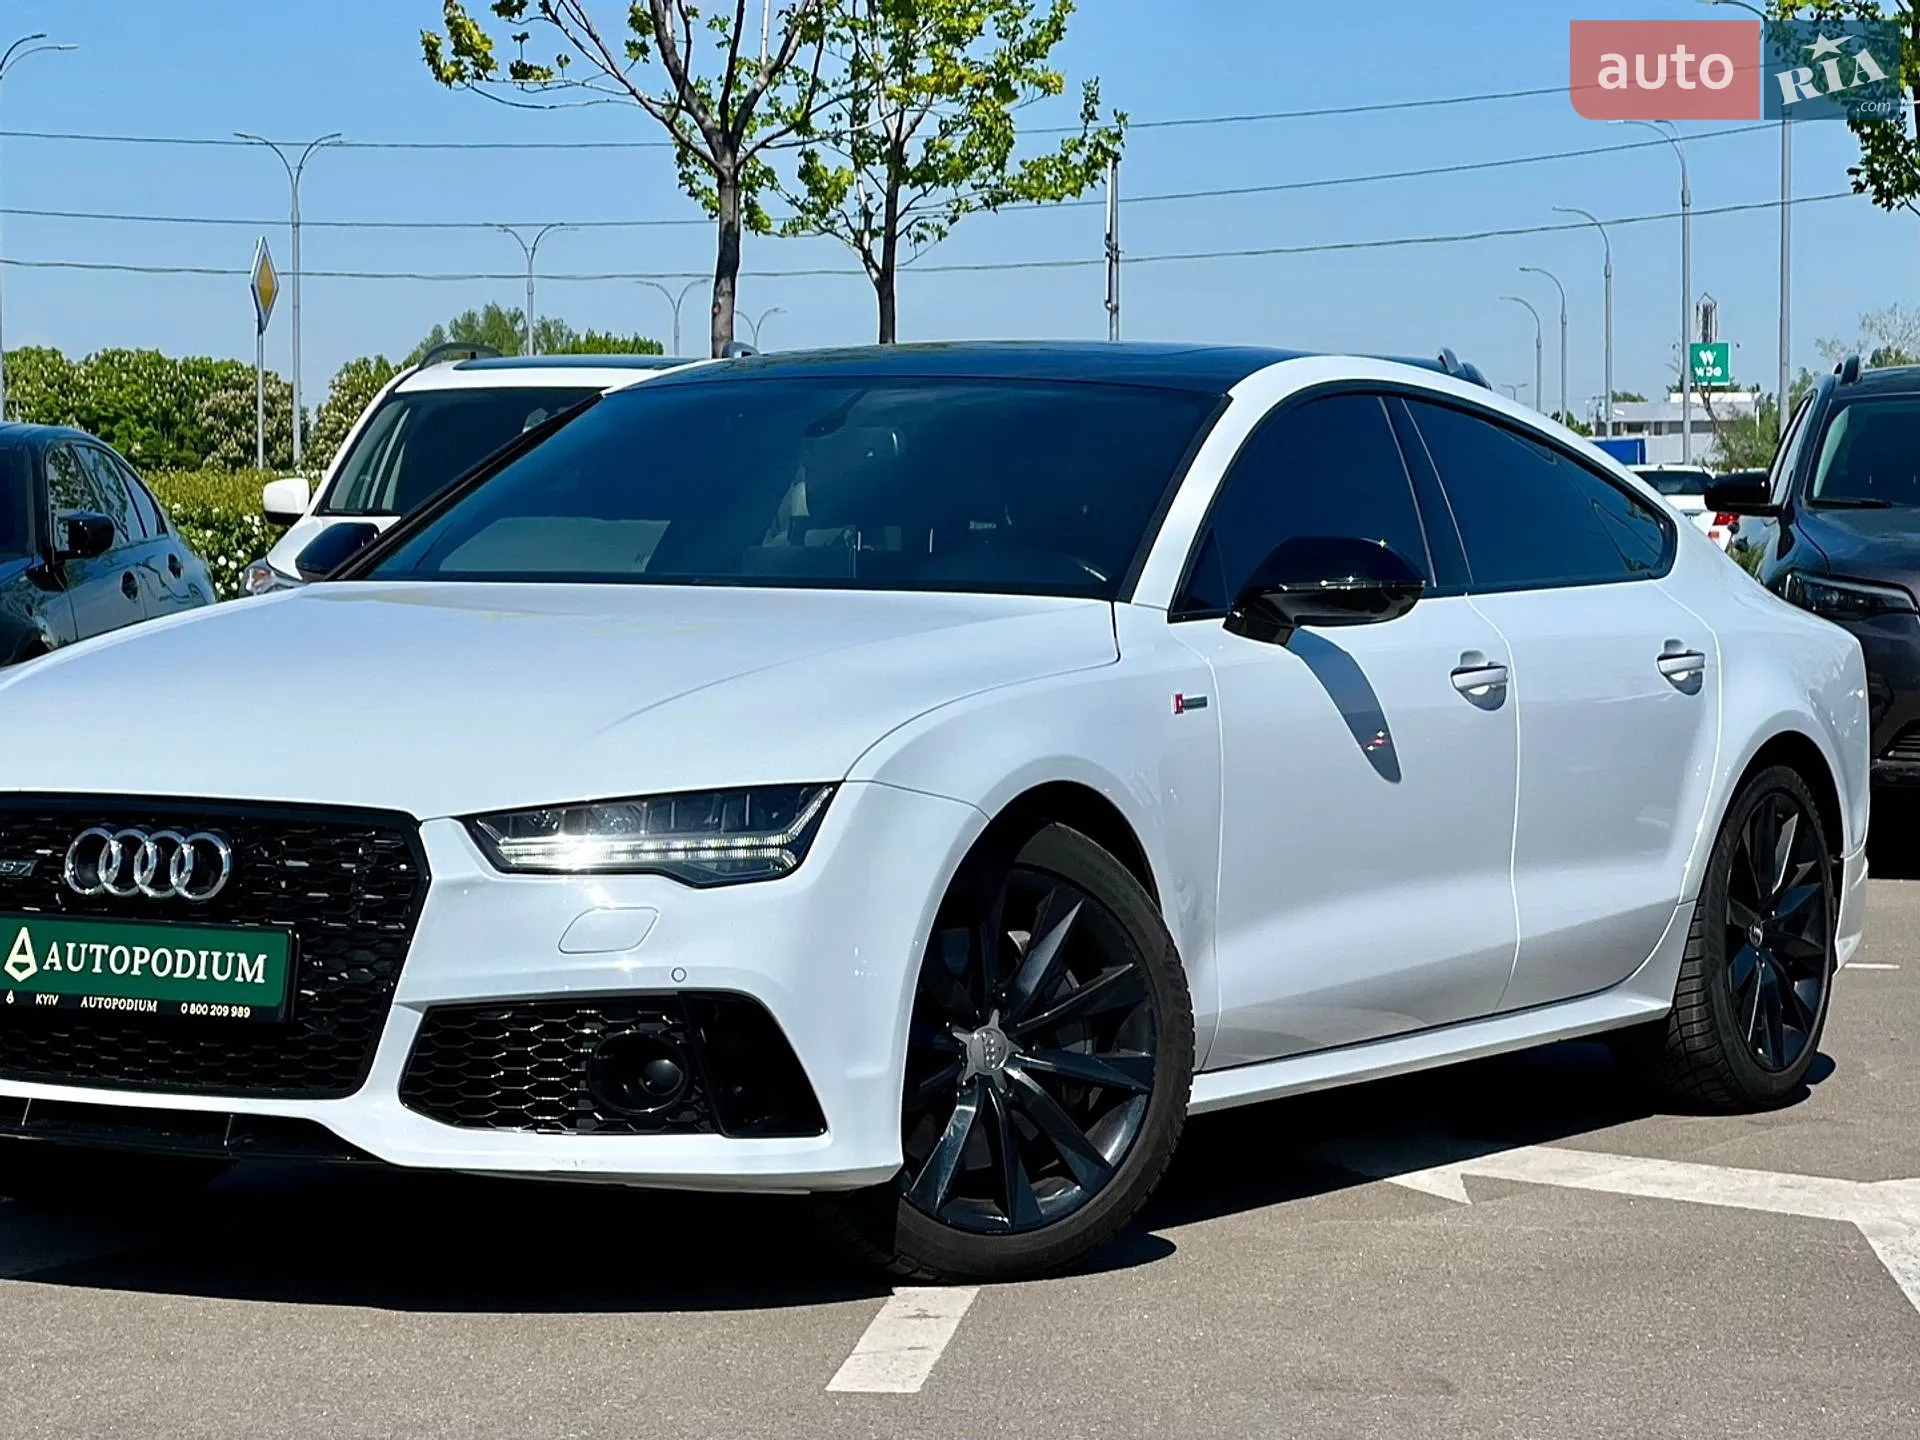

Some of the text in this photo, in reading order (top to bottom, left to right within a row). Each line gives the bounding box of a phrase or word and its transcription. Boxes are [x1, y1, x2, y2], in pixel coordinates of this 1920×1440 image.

[43, 941, 268, 984] AUTOPODIUM
[35, 992, 59, 1006] KYIV
[80, 996, 157, 1013] AUTOPODIUM
[189, 1003, 208, 1016] 800
[210, 1004, 229, 1017] 209
[231, 1005, 250, 1018] 989
